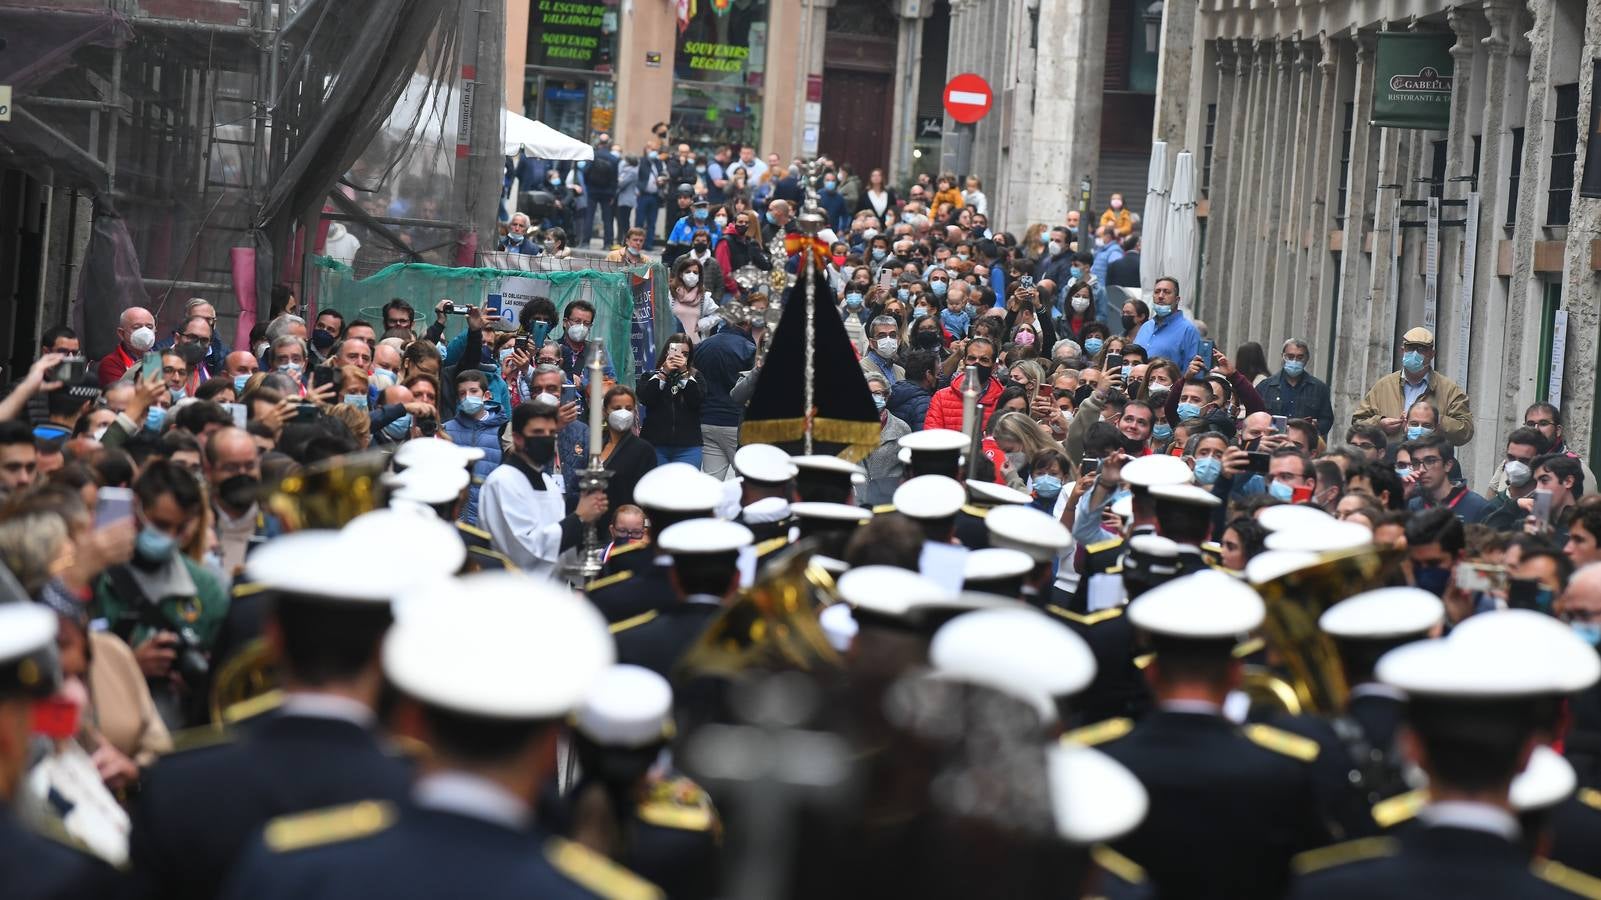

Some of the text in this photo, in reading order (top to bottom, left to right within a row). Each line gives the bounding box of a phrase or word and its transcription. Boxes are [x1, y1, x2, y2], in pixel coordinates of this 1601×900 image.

[539, 1, 607, 16] EL ESCUDO DE
[543, 13, 602, 27] VALLADOLID
[541, 33, 598, 48] SOUVENIRS
[546, 46, 592, 60] REGALOS
[684, 41, 749, 59] SOUVENIRS
[690, 56, 742, 72] REGALOS
[1388, 93, 1433, 102] RISTORANTE
